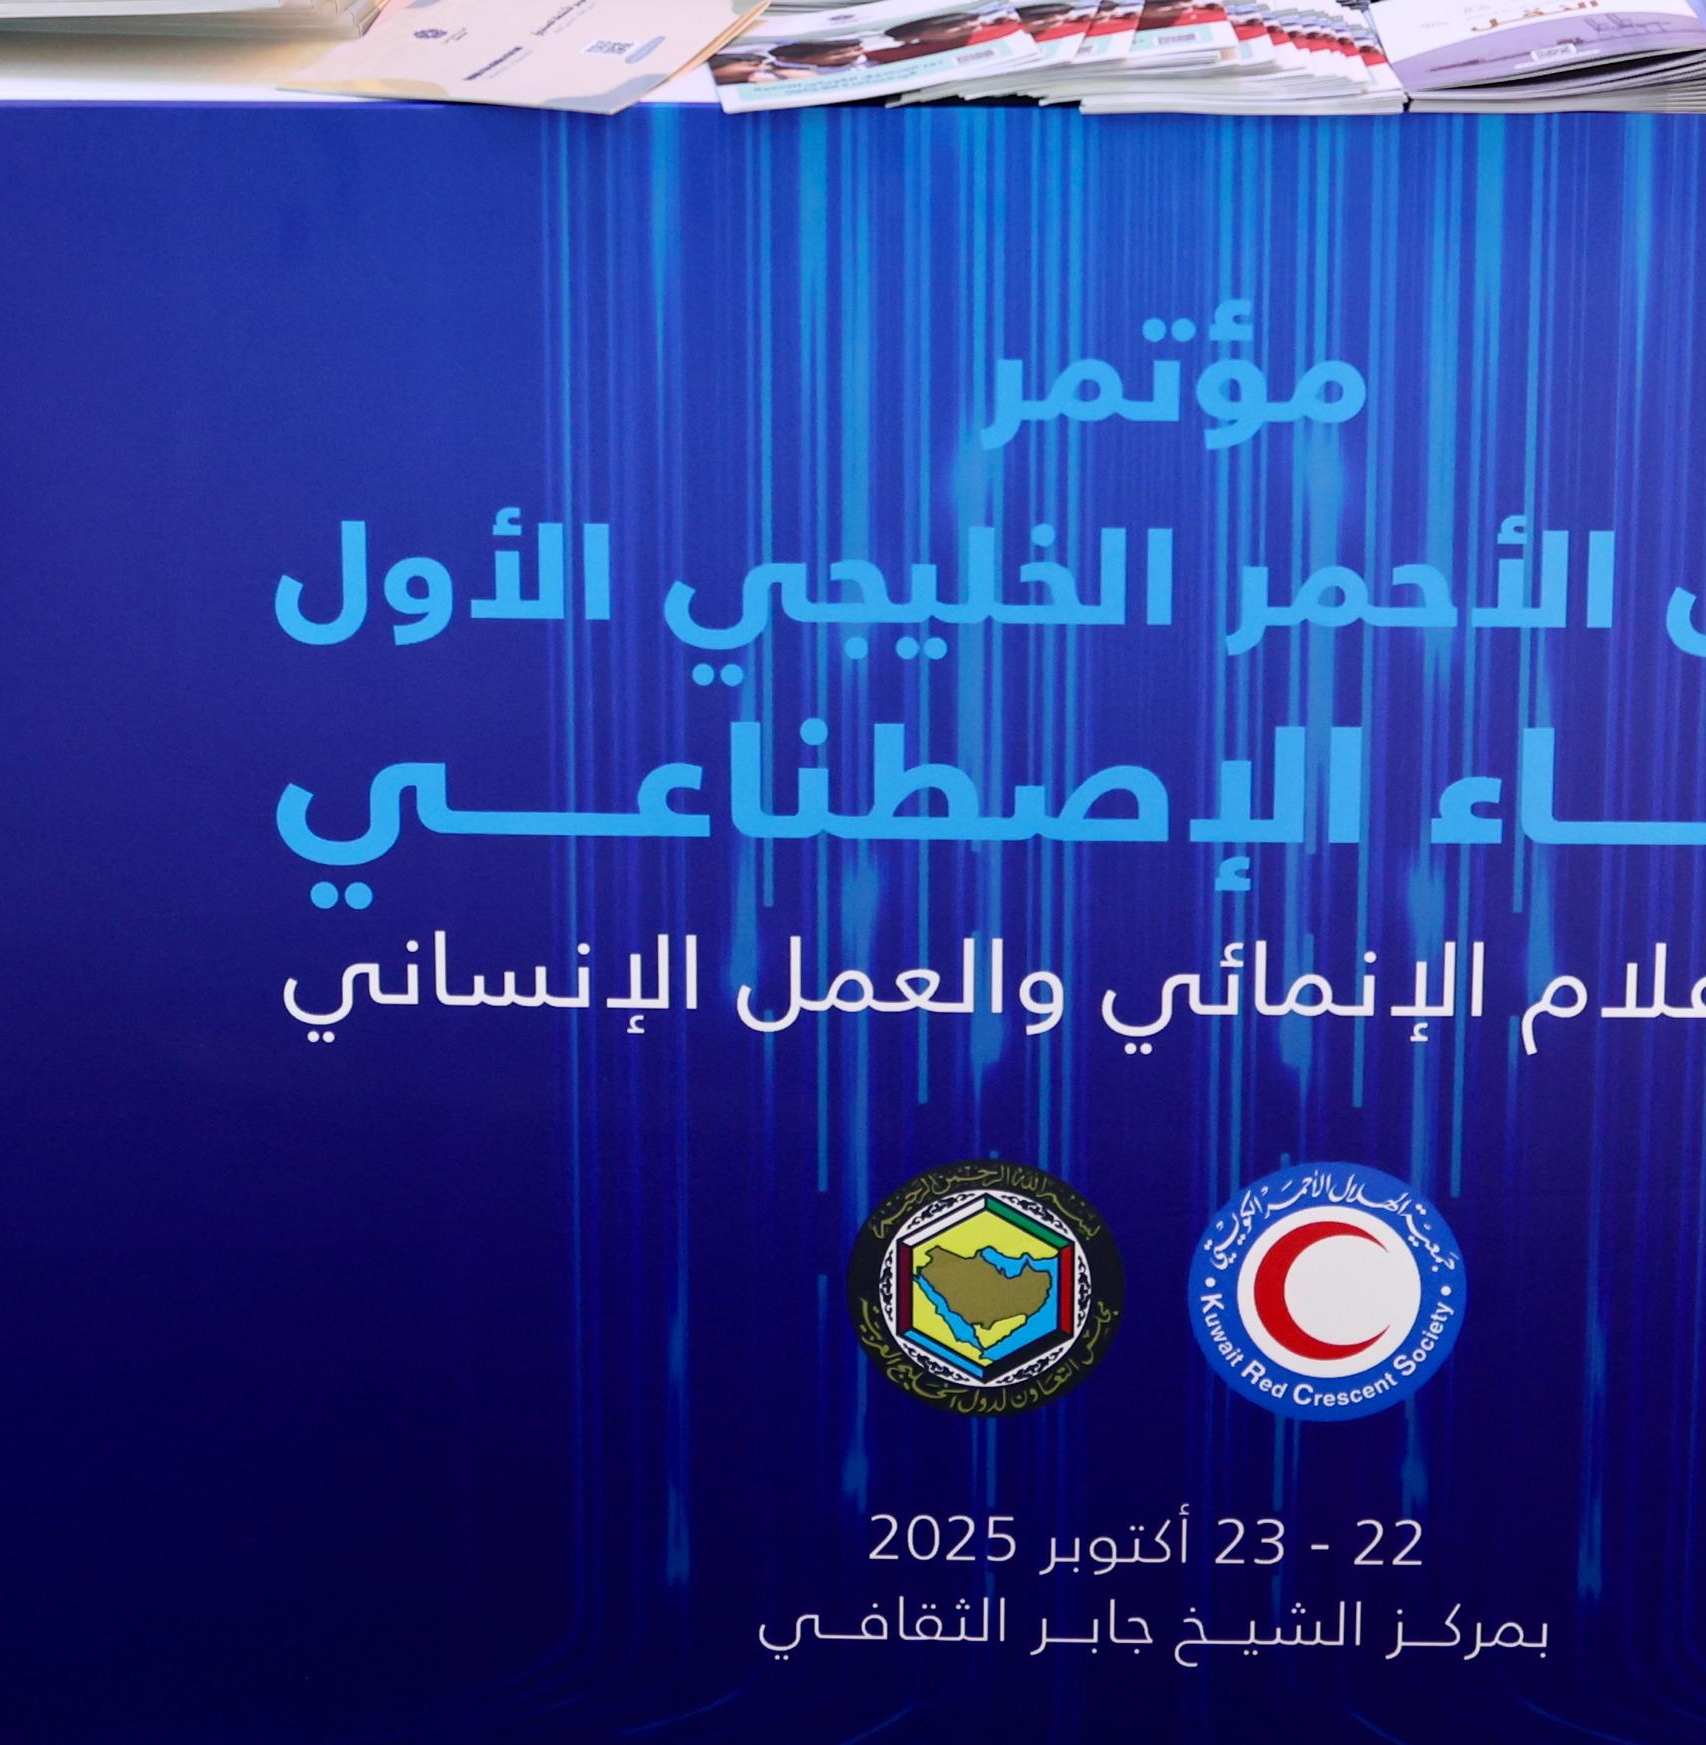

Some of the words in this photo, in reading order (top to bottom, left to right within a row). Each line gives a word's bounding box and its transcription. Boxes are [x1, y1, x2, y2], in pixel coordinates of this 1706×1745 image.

[980, 299, 1366, 451] مؤتمر
[274, 507, 611, 645] الأول
[663, 523, 1173, 686] الخليجي
[1227, 515, 1615, 656] الأحمر
[276, 717, 1362, 910] الإصطناعي
[283, 930, 697, 1043] الإنساني
[736, 935, 1064, 1036] والعمل
[1101, 940, 1484, 1055] الإنمائي
[1200, 1293, 1244, 1367] Kuwait
[1241, 1359, 1288, 1398] Red
[1293, 1372, 1399, 1407] Crescent
[1393, 1301, 1454, 1376] Society
[868, 1513, 1017, 1563] 2025
[1038, 1502, 1190, 1576] أكتوبر
[1215, 1518, 1285, 1566] 23
[1353, 1518, 1423, 1566] 22
[758, 1595, 1006, 1661] الثقافي
[1029, 1599, 1154, 1657] جابر
[1173, 1601, 1362, 1668] الشيخ
[1384, 1602, 1549, 1661] بمركز
